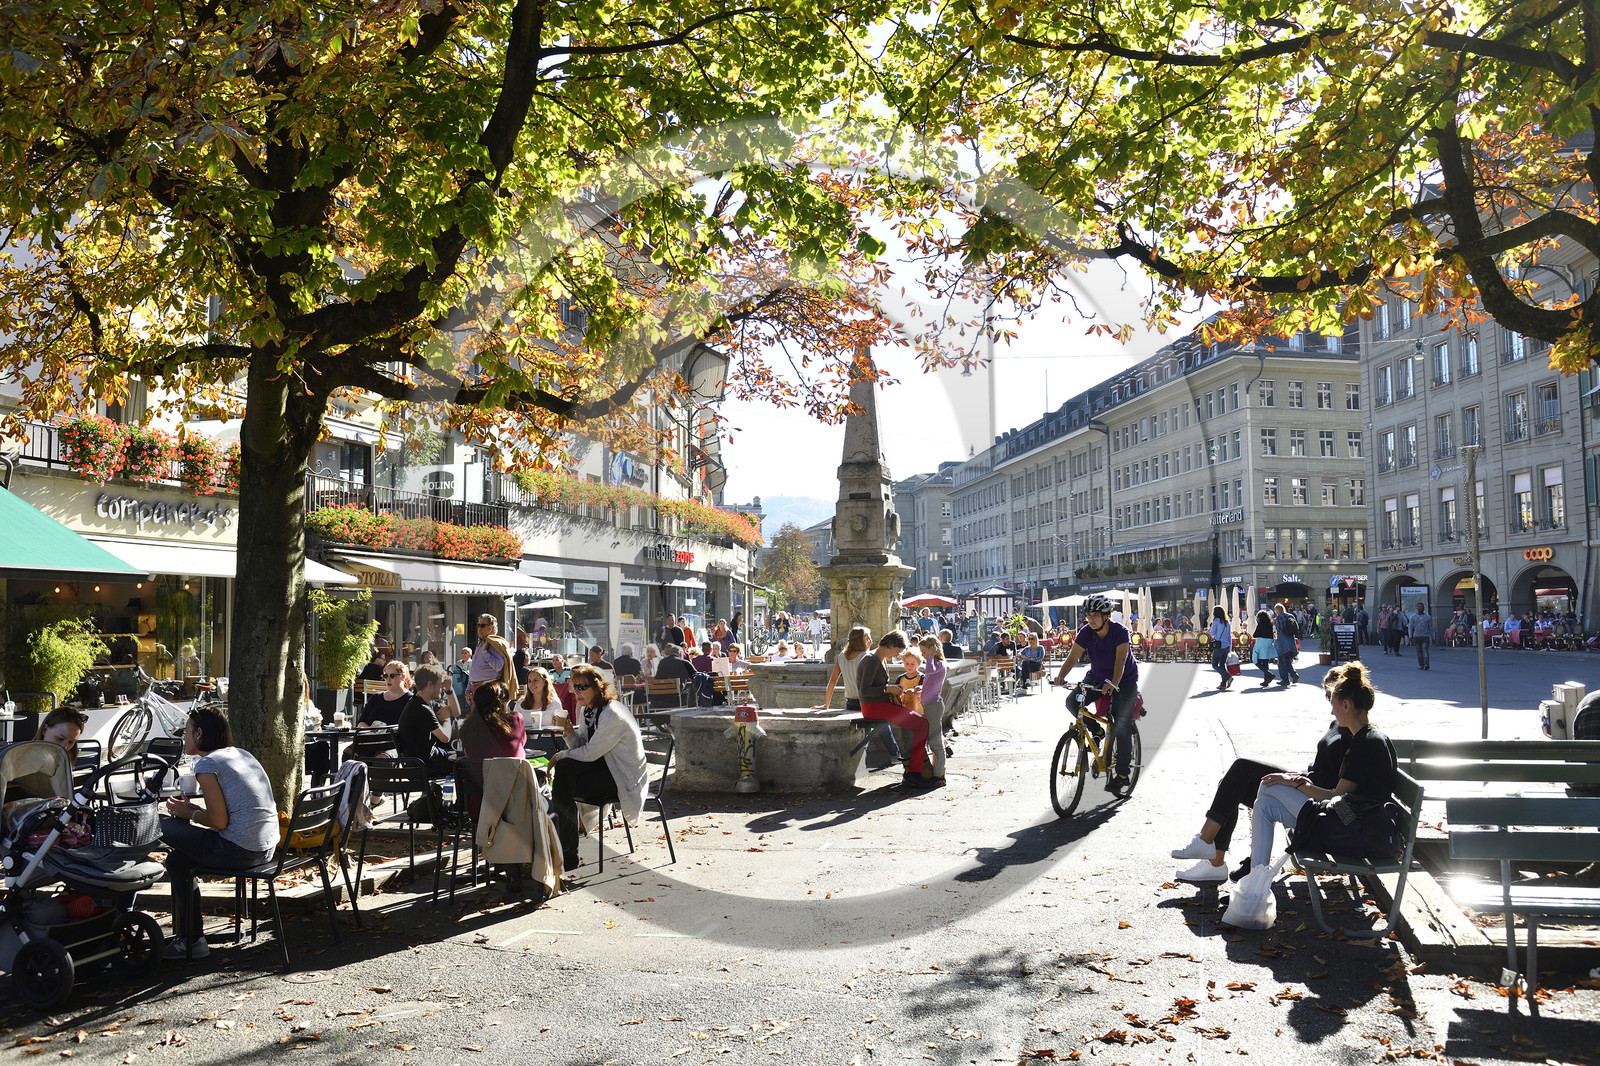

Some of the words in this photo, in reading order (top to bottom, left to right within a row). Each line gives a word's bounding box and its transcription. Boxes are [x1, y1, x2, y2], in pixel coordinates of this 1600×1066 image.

[646, 543, 695, 564] mobilezone
[1523, 547, 1553, 563] coop
[1282, 573, 1302, 583] Salt.
